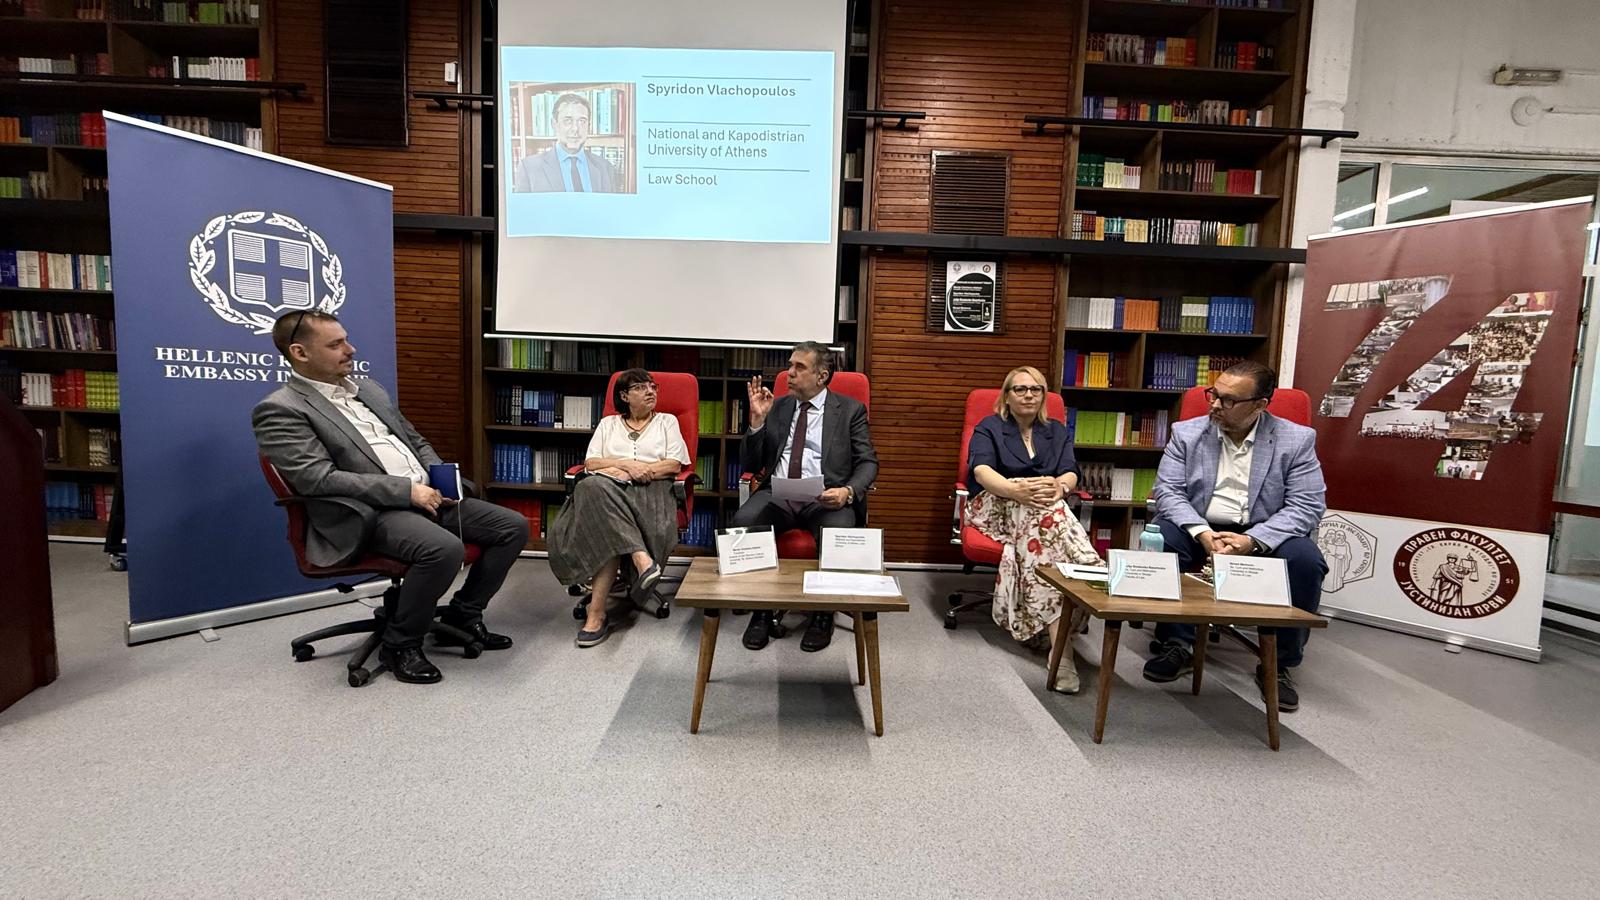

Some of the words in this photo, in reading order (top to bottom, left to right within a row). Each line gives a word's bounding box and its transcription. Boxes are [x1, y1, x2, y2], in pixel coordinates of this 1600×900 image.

[647, 83, 704, 96] Spyridon
[707, 85, 796, 98] Vlachopoulos
[648, 127, 698, 139] National
[702, 129, 725, 141] and
[728, 130, 805, 143] Kapodistrian
[648, 144, 708, 158] University
[710, 145, 722, 157] of
[725, 146, 768, 158] Athens
[648, 173, 672, 184] Law
[675, 173, 718, 185] School
[155, 346, 273, 367] HELLENIC
[164, 364, 272, 383] EMBASSY
[1404, 530, 1446, 553] ПРАВЕН
[1450, 530, 1511, 565] ФАКУЛТЕТ
[1400, 581, 1472, 617] ЈУСТИНИЈАН
[1474, 594, 1507, 615] ПРВИ
